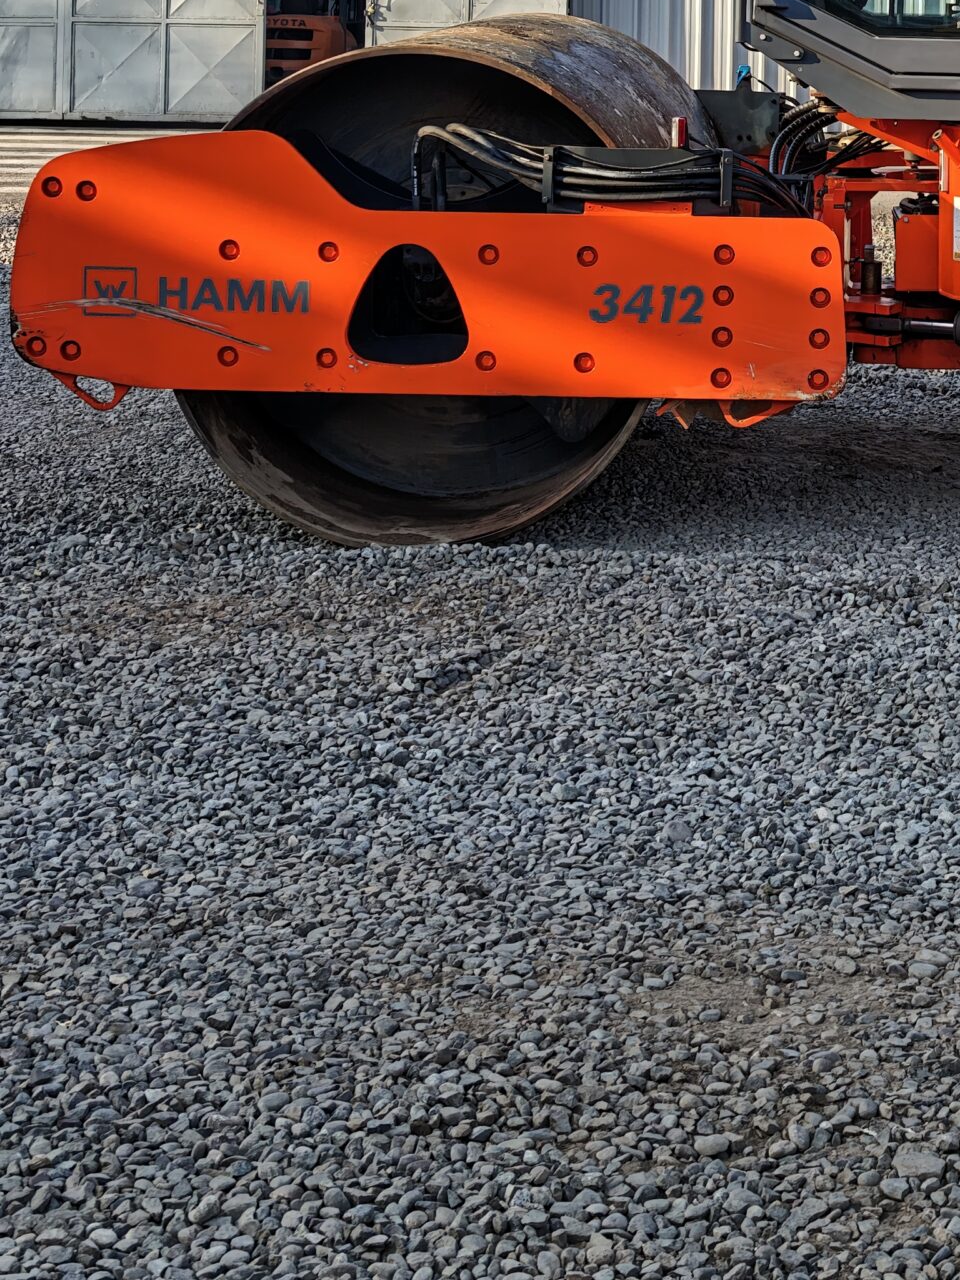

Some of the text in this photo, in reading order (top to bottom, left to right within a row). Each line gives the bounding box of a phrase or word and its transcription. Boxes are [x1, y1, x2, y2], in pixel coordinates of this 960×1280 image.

[267, 18, 307, 27] YOTA
[159, 276, 310, 314] HAMM
[588, 283, 705, 324] 3412
